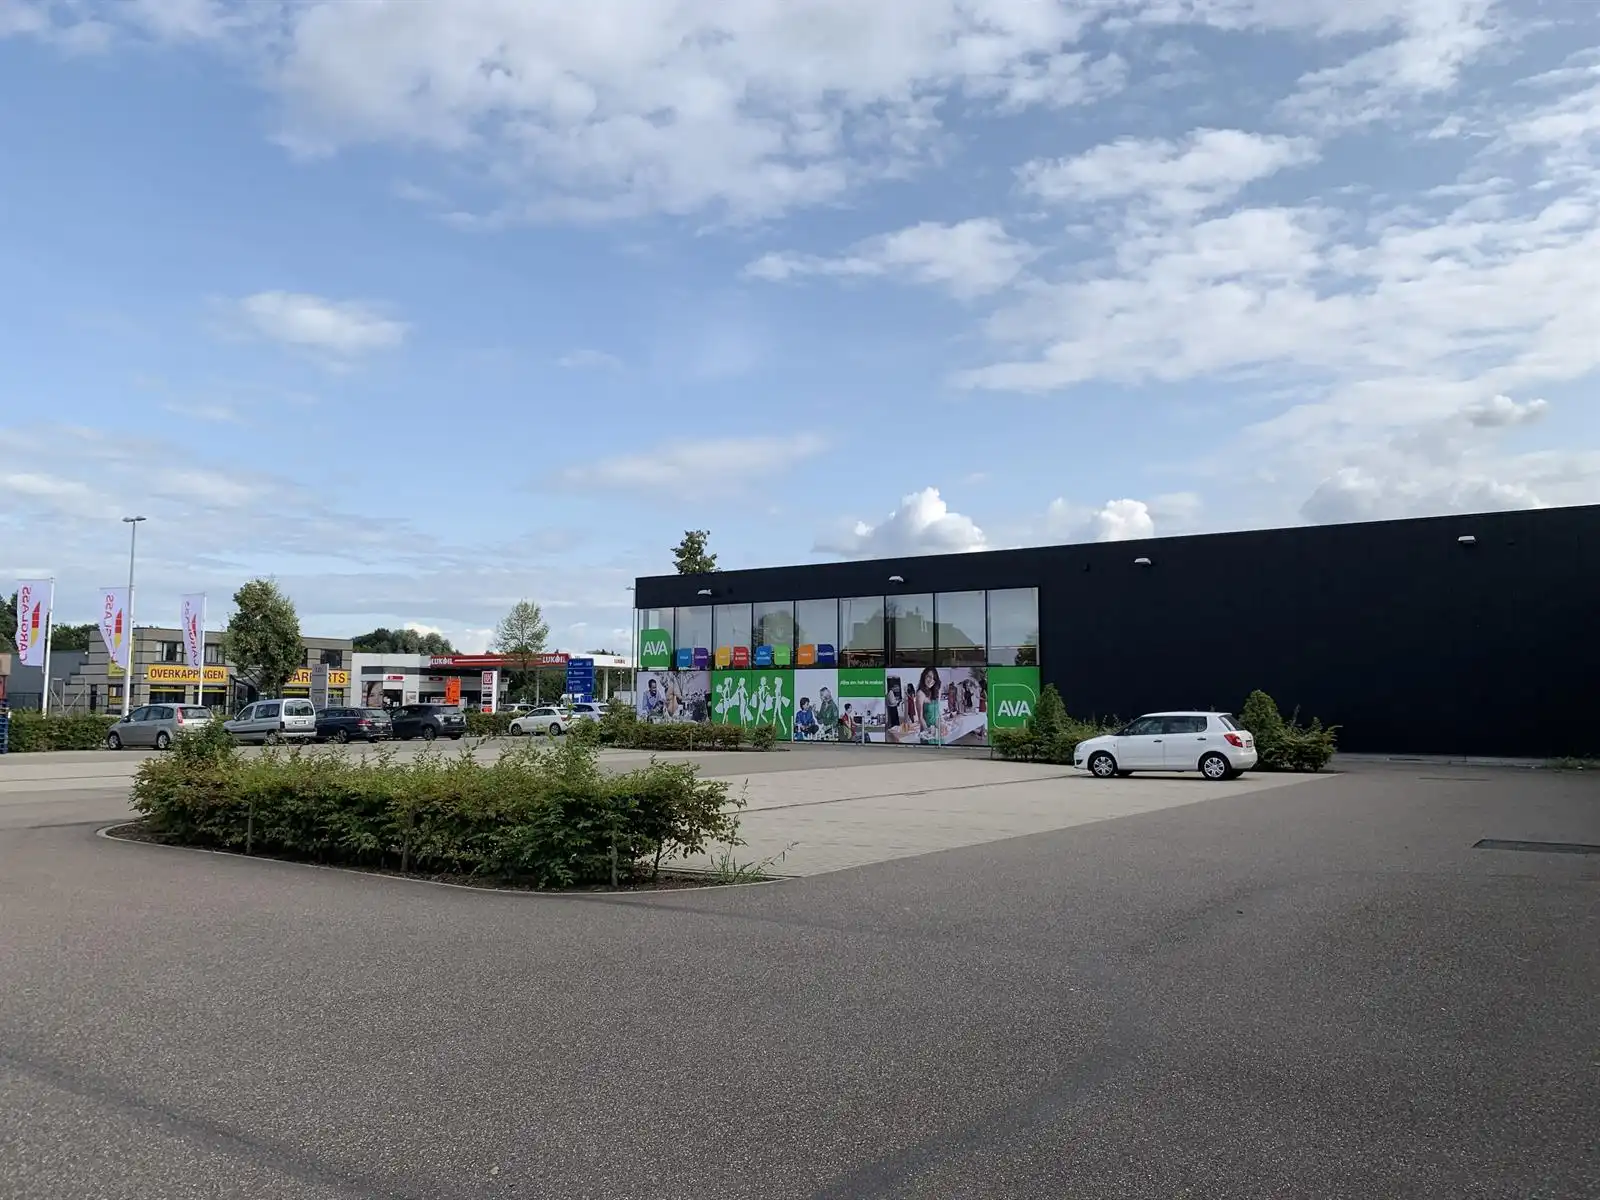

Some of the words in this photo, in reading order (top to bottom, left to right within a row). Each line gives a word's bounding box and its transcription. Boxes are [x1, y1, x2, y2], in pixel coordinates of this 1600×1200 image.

[642, 640, 668, 656] AVA
[431, 657, 453, 665] LUKOIL
[543, 655, 566, 664] LUKOIL
[150, 668, 224, 679] OVERKAPPINGEN
[997, 700, 1033, 717] AVA
